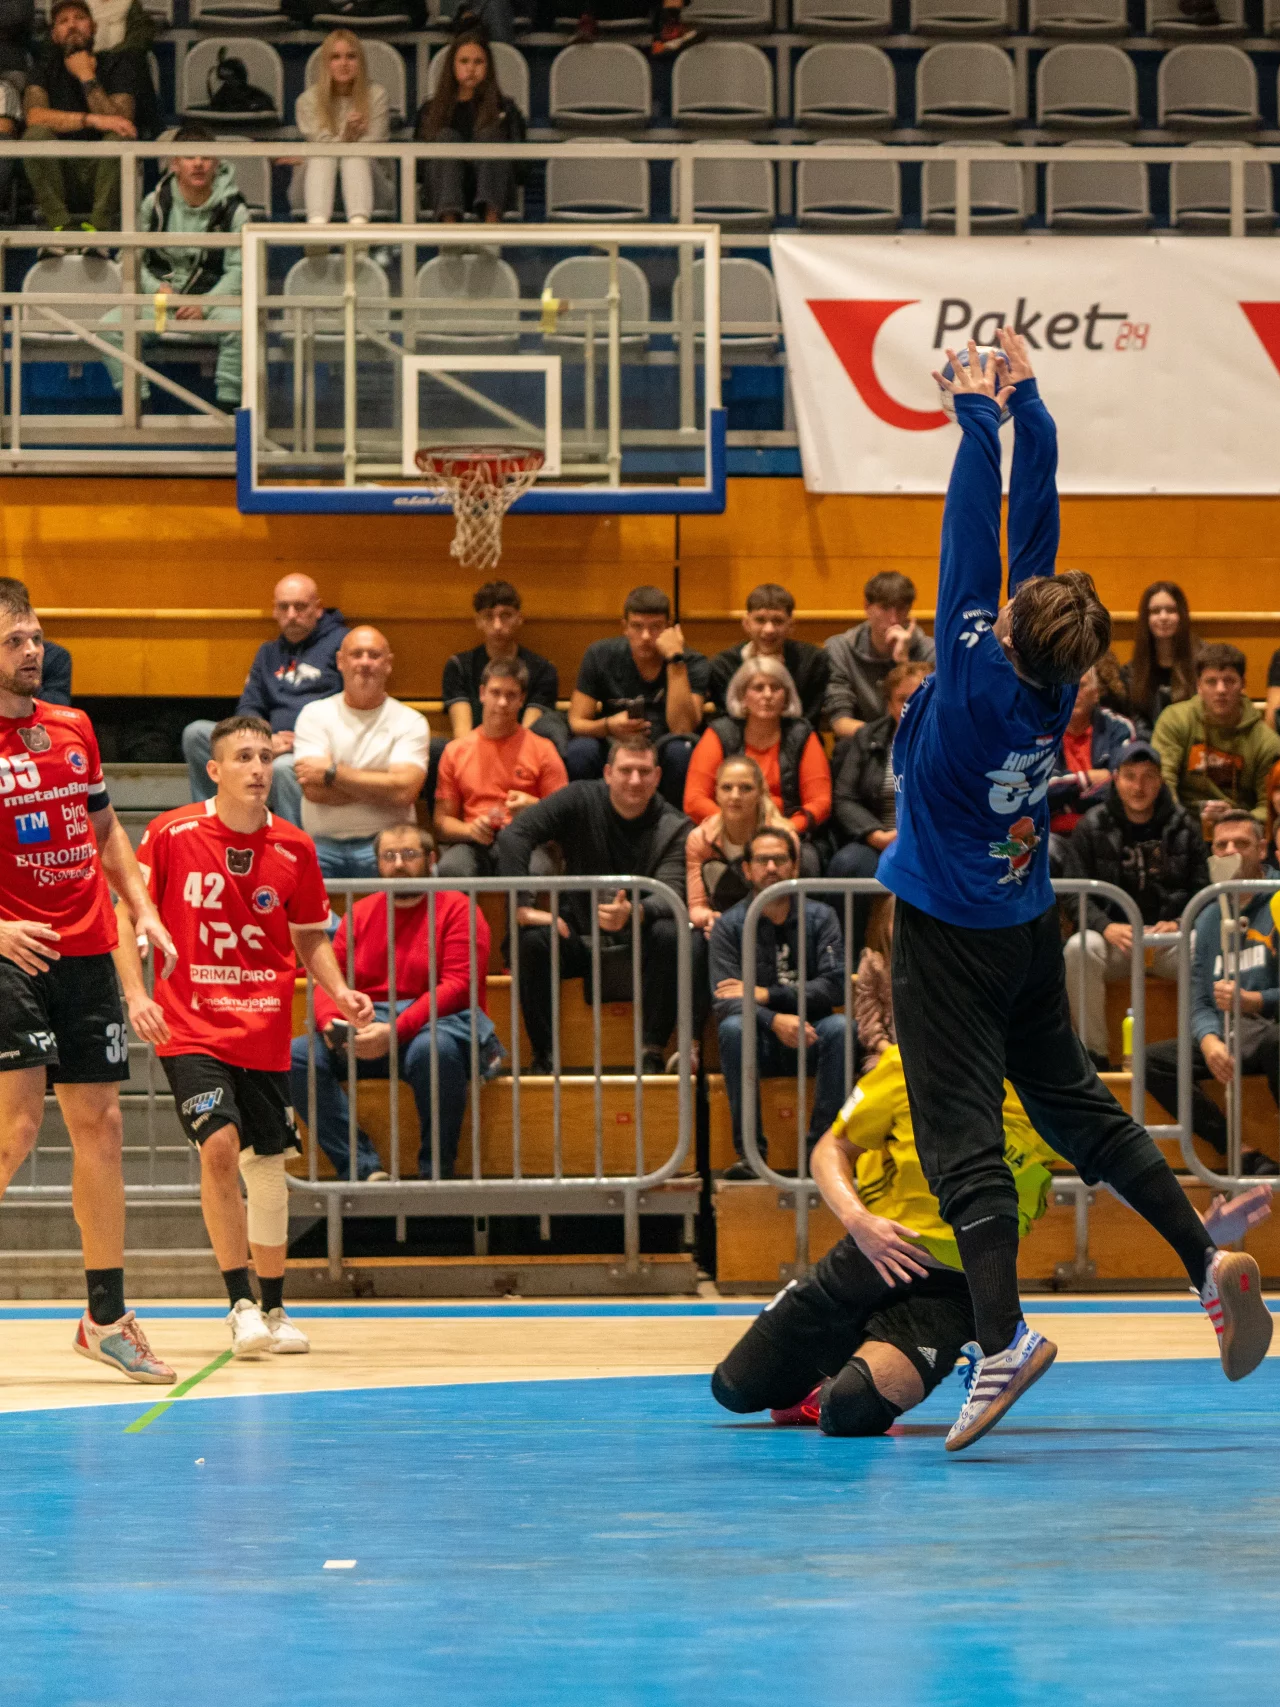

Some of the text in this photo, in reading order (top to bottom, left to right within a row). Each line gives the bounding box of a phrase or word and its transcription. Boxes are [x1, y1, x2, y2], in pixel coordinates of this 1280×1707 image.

[933, 297, 1151, 351] Paket 24
[15, 811, 49, 831] TM
[66, 819, 88, 840] plus
[183, 871, 225, 909] 42
[191, 967, 238, 981] PRIMA
